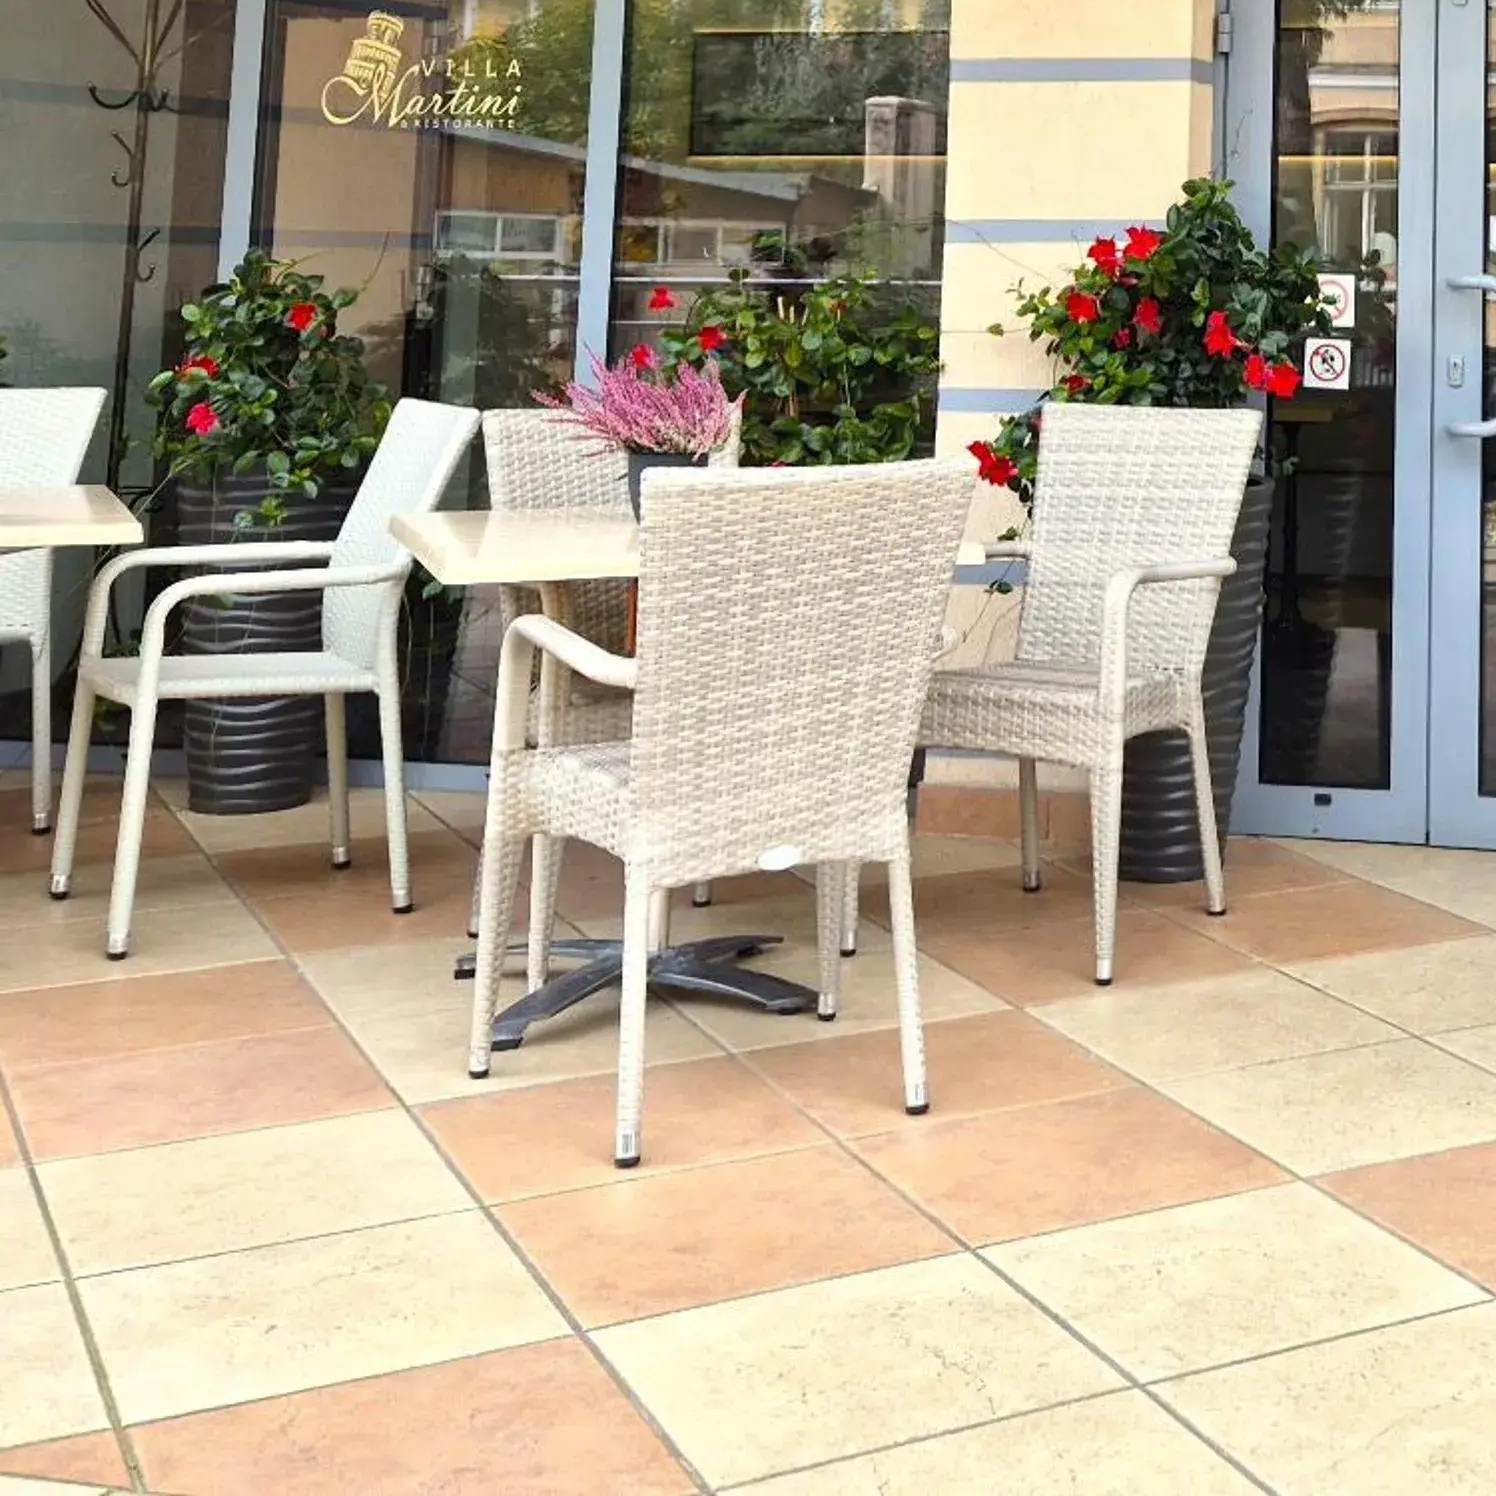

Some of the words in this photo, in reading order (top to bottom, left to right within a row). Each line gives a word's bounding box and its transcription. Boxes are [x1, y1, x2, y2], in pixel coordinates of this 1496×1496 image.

[421, 59, 521, 77] VILLA
[321, 61, 522, 127] Martini
[414, 119, 515, 129] RISTORANTE
